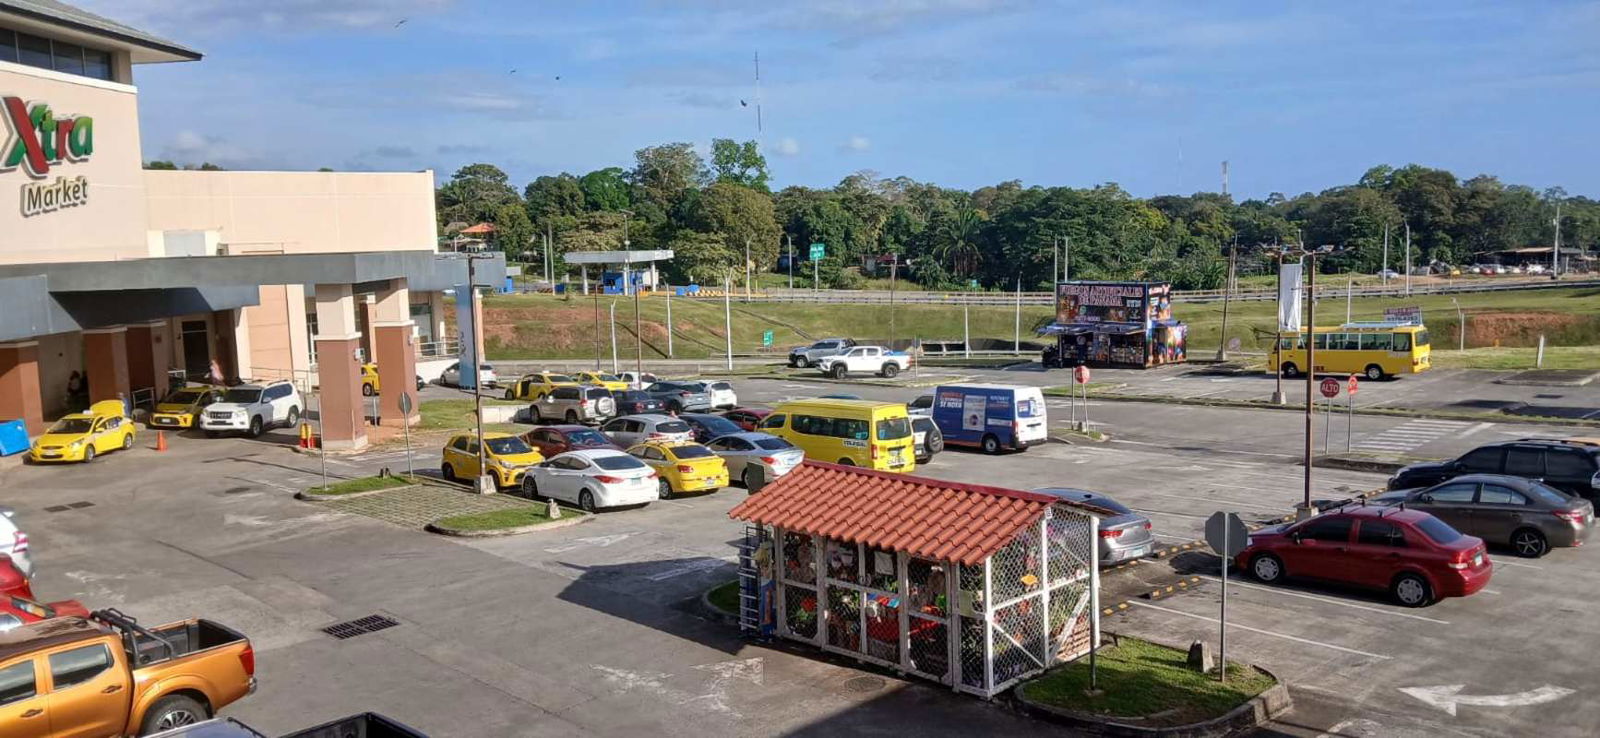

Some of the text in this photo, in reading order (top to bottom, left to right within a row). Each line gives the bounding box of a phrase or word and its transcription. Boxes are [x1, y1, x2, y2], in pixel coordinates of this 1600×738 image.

[2, 96, 94, 175] Xtra
[27, 178, 88, 211] Market
[1321, 383, 1339, 393] ALTO
